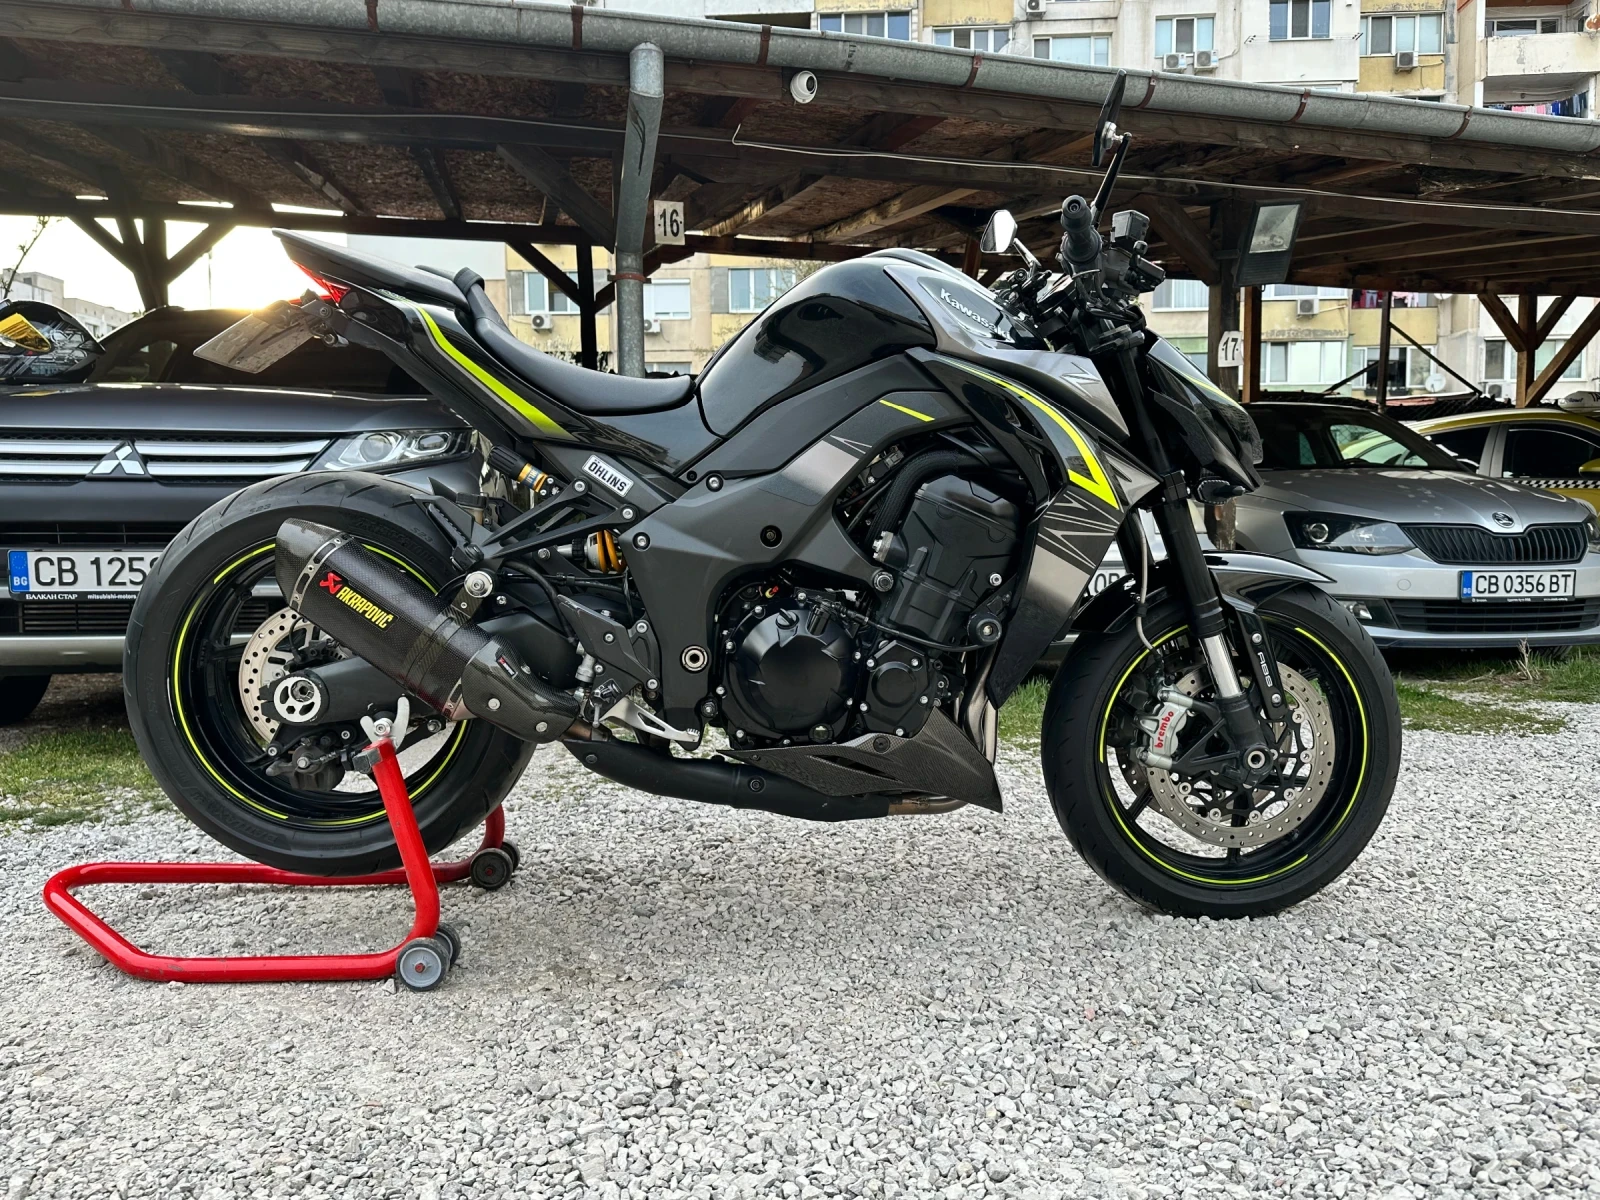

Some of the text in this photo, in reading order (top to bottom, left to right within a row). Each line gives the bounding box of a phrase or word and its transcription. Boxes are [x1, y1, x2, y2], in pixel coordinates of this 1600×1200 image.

[660, 208, 680, 237] 16
[940, 287, 1013, 343] Kawasaki
[1222, 336, 1239, 361] 17
[587, 459, 628, 492] ÖHLINS
[13, 576, 28, 586] BG
[34, 556, 79, 587] CB
[1475, 574, 1571, 594] CB 0356 BT
[1154, 711, 1174, 748] brembo
